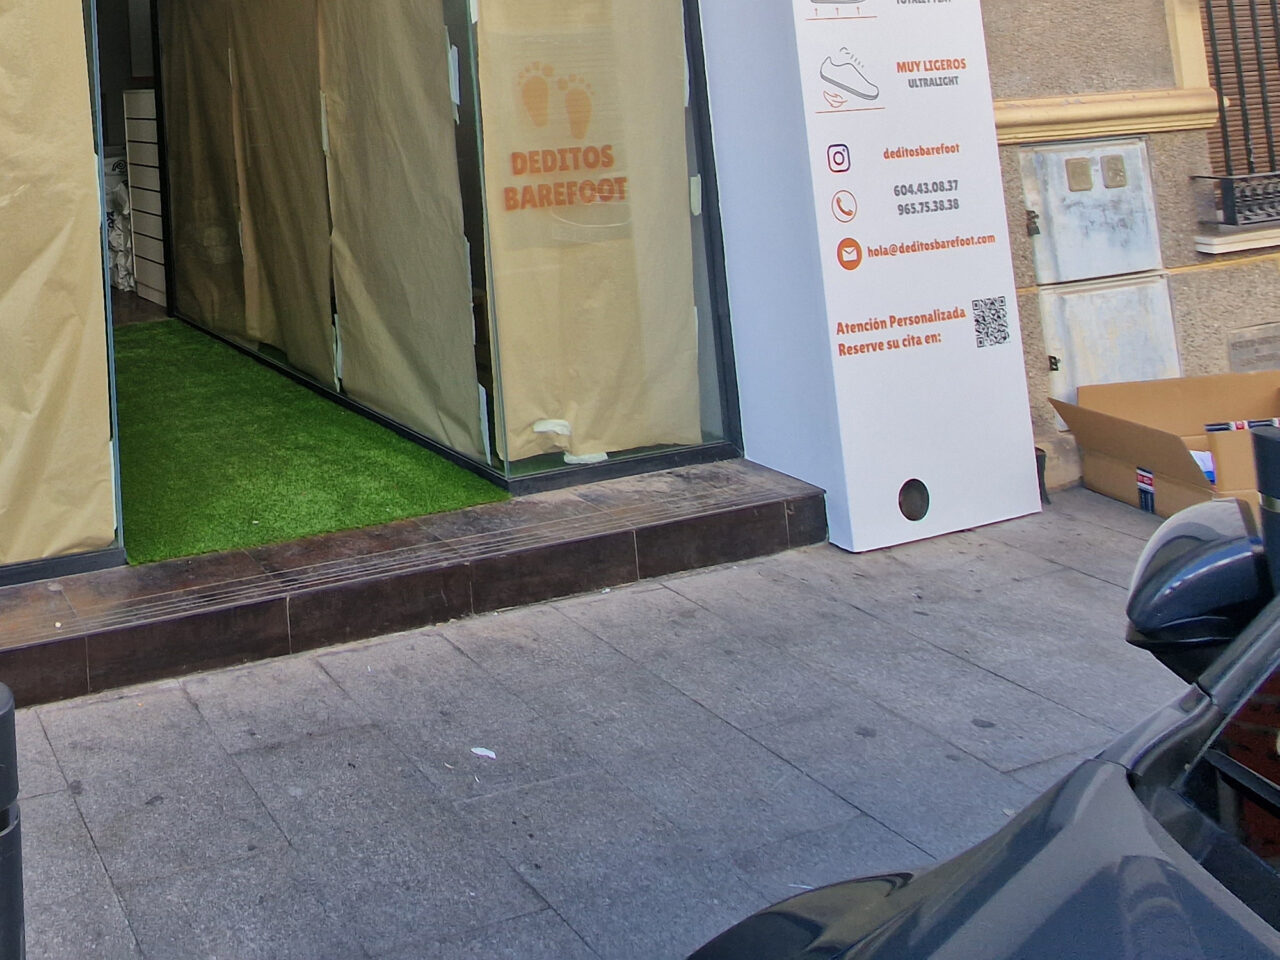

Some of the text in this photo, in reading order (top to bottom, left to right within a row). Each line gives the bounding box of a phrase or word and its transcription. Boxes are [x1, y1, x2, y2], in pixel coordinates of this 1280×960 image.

[896, 58, 967, 73] MUY LIGEROS
[908, 76, 959, 88] ULTRALIGHT
[510, 144, 614, 176] DEDITOS
[883, 143, 960, 160] deditosbarefoot
[503, 176, 628, 212] BAREFOOT
[893, 179, 959, 197] 604.43.08.37
[867, 233, 996, 258] hola@deditosbarefoot.com
[836, 306, 967, 335] Atención Personalizada
[838, 332, 942, 357] Reserve su cita en:
